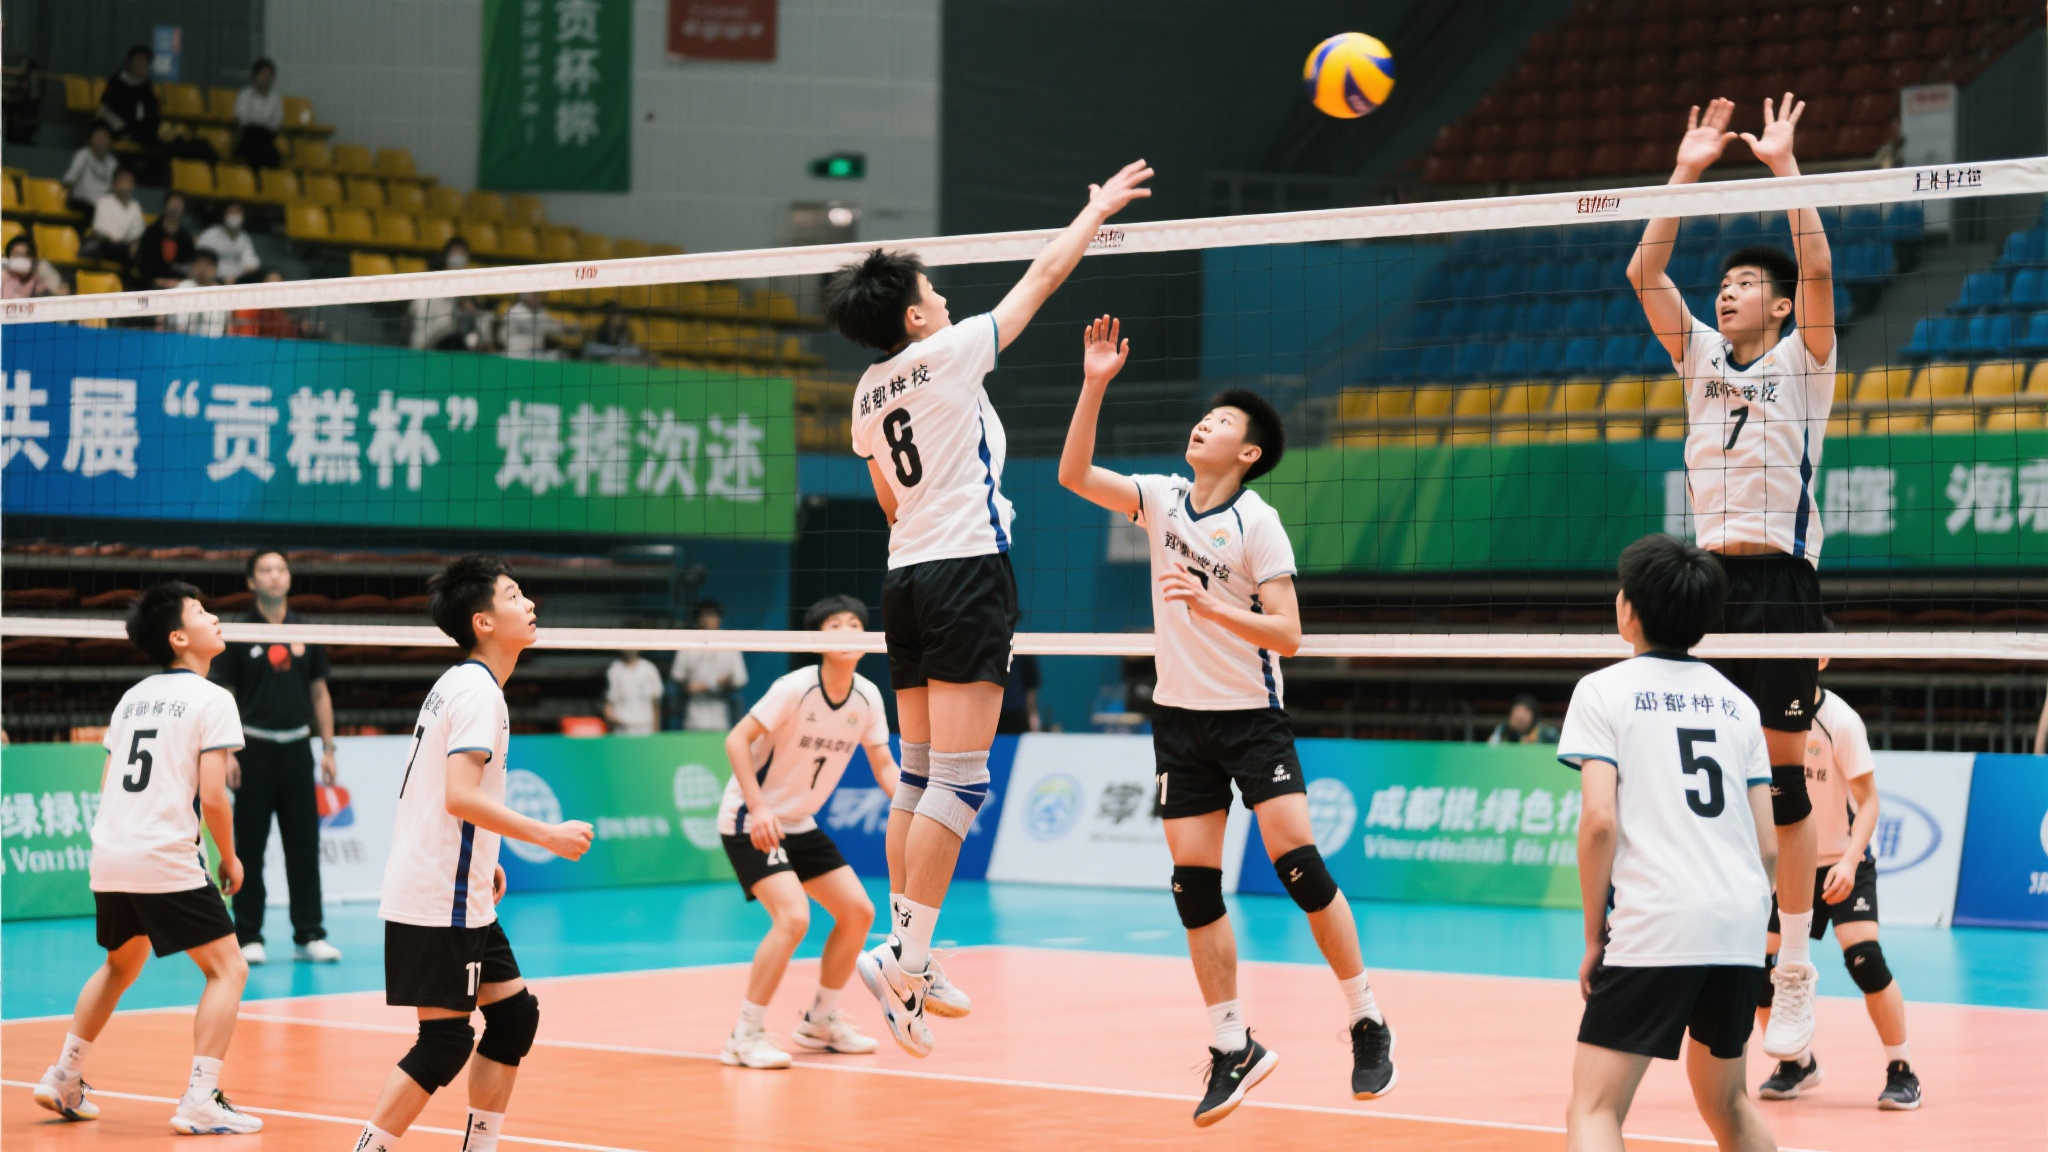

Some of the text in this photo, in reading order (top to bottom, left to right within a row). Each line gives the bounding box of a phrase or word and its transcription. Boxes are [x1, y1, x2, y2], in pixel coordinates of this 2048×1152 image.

[883, 408, 923, 488] 8
[1725, 406, 1749, 450] 7
[123, 729, 158, 793] 5
[1676, 727, 1726, 819] 5
